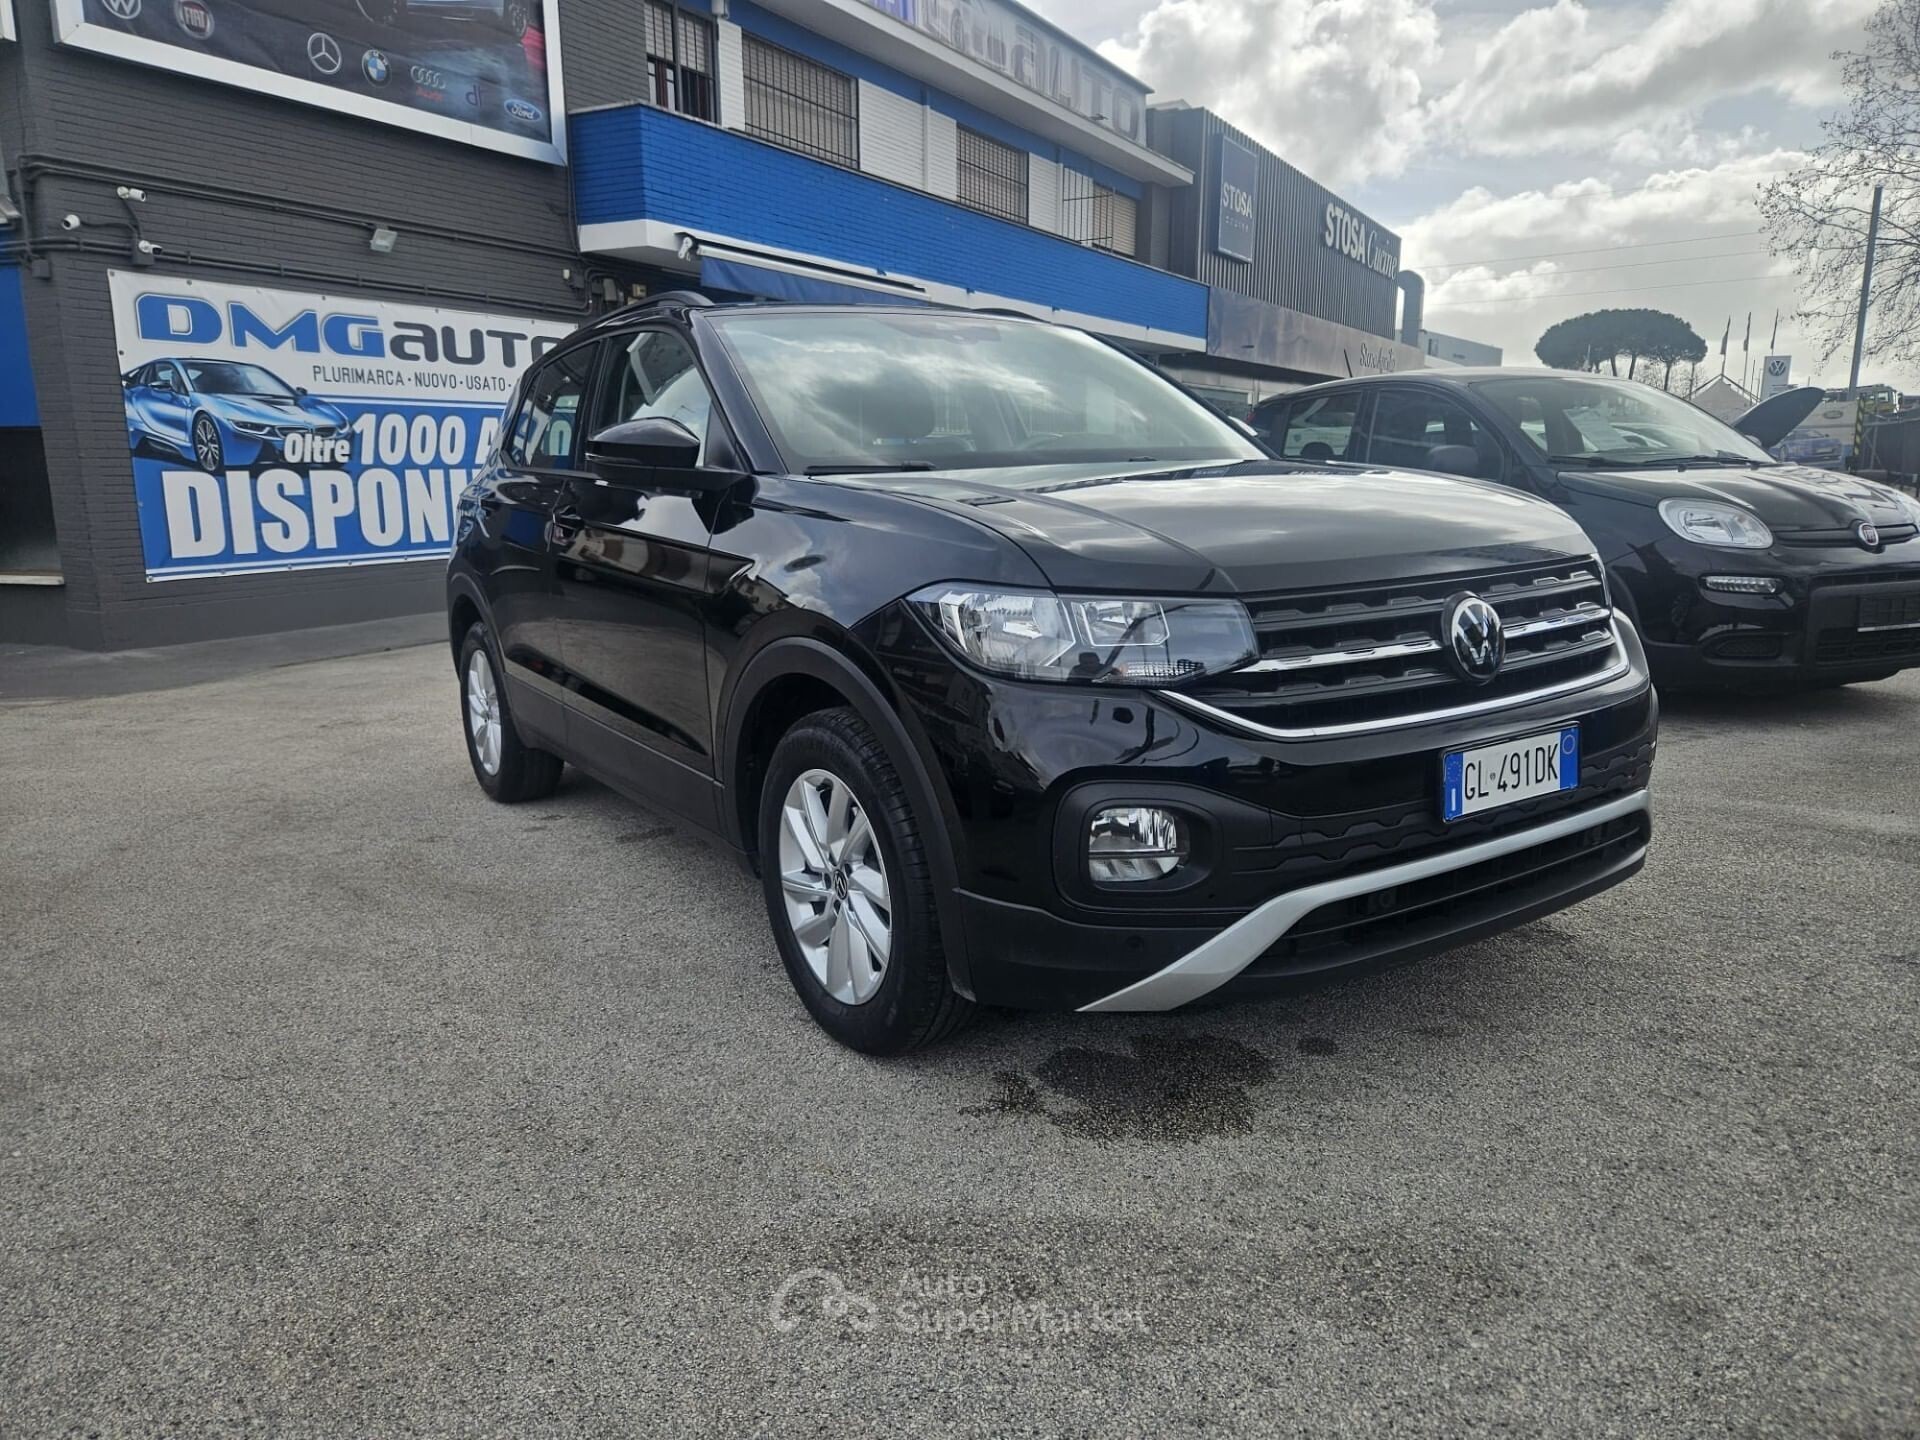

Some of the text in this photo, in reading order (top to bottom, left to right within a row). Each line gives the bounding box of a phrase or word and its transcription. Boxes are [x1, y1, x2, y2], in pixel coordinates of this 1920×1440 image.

[183, 6, 206, 29] FIAT
[1222, 181, 1253, 220] STOSA
[1325, 202, 1367, 264] STOSA
[312, 365, 506, 393] PLURIMARCA NUOVO USATO
[283, 432, 350, 464] Oltre
[352, 412, 467, 467] 1000
[161, 468, 487, 560] DISPONI
